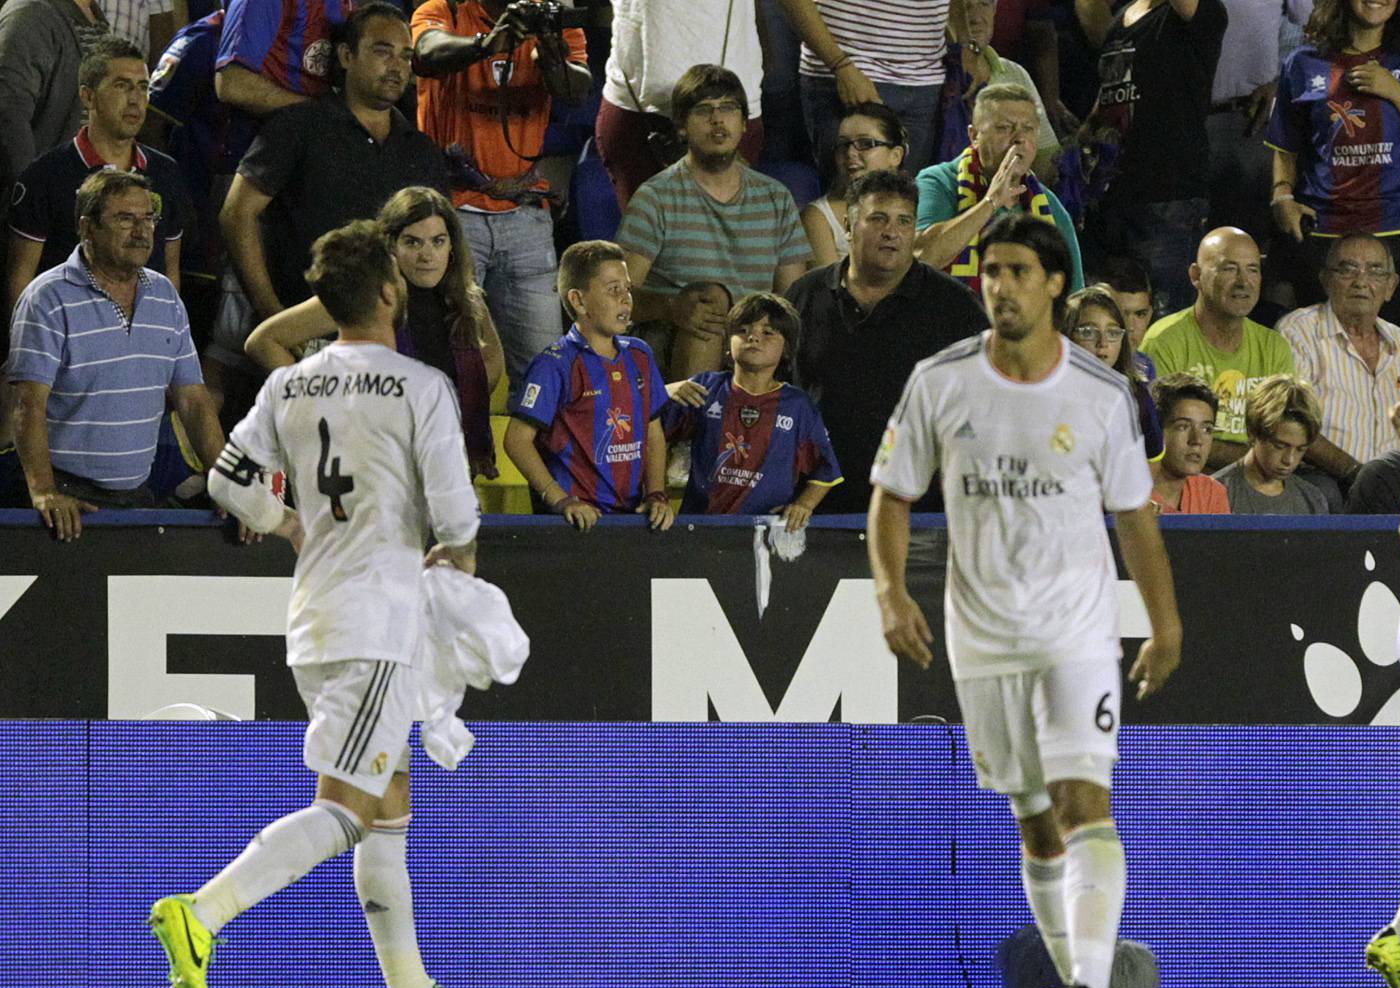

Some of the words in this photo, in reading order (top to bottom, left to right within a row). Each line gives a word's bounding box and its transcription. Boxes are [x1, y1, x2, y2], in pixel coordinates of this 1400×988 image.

[1333, 142, 1394, 155] COMUNITAT
[282, 374, 339, 400] SERGIO
[343, 372, 406, 397] RAMOS
[317, 416, 355, 522] 4
[997, 454, 1029, 475] Fly
[962, 473, 1066, 498] Emirates
[1095, 692, 1114, 733] 6
